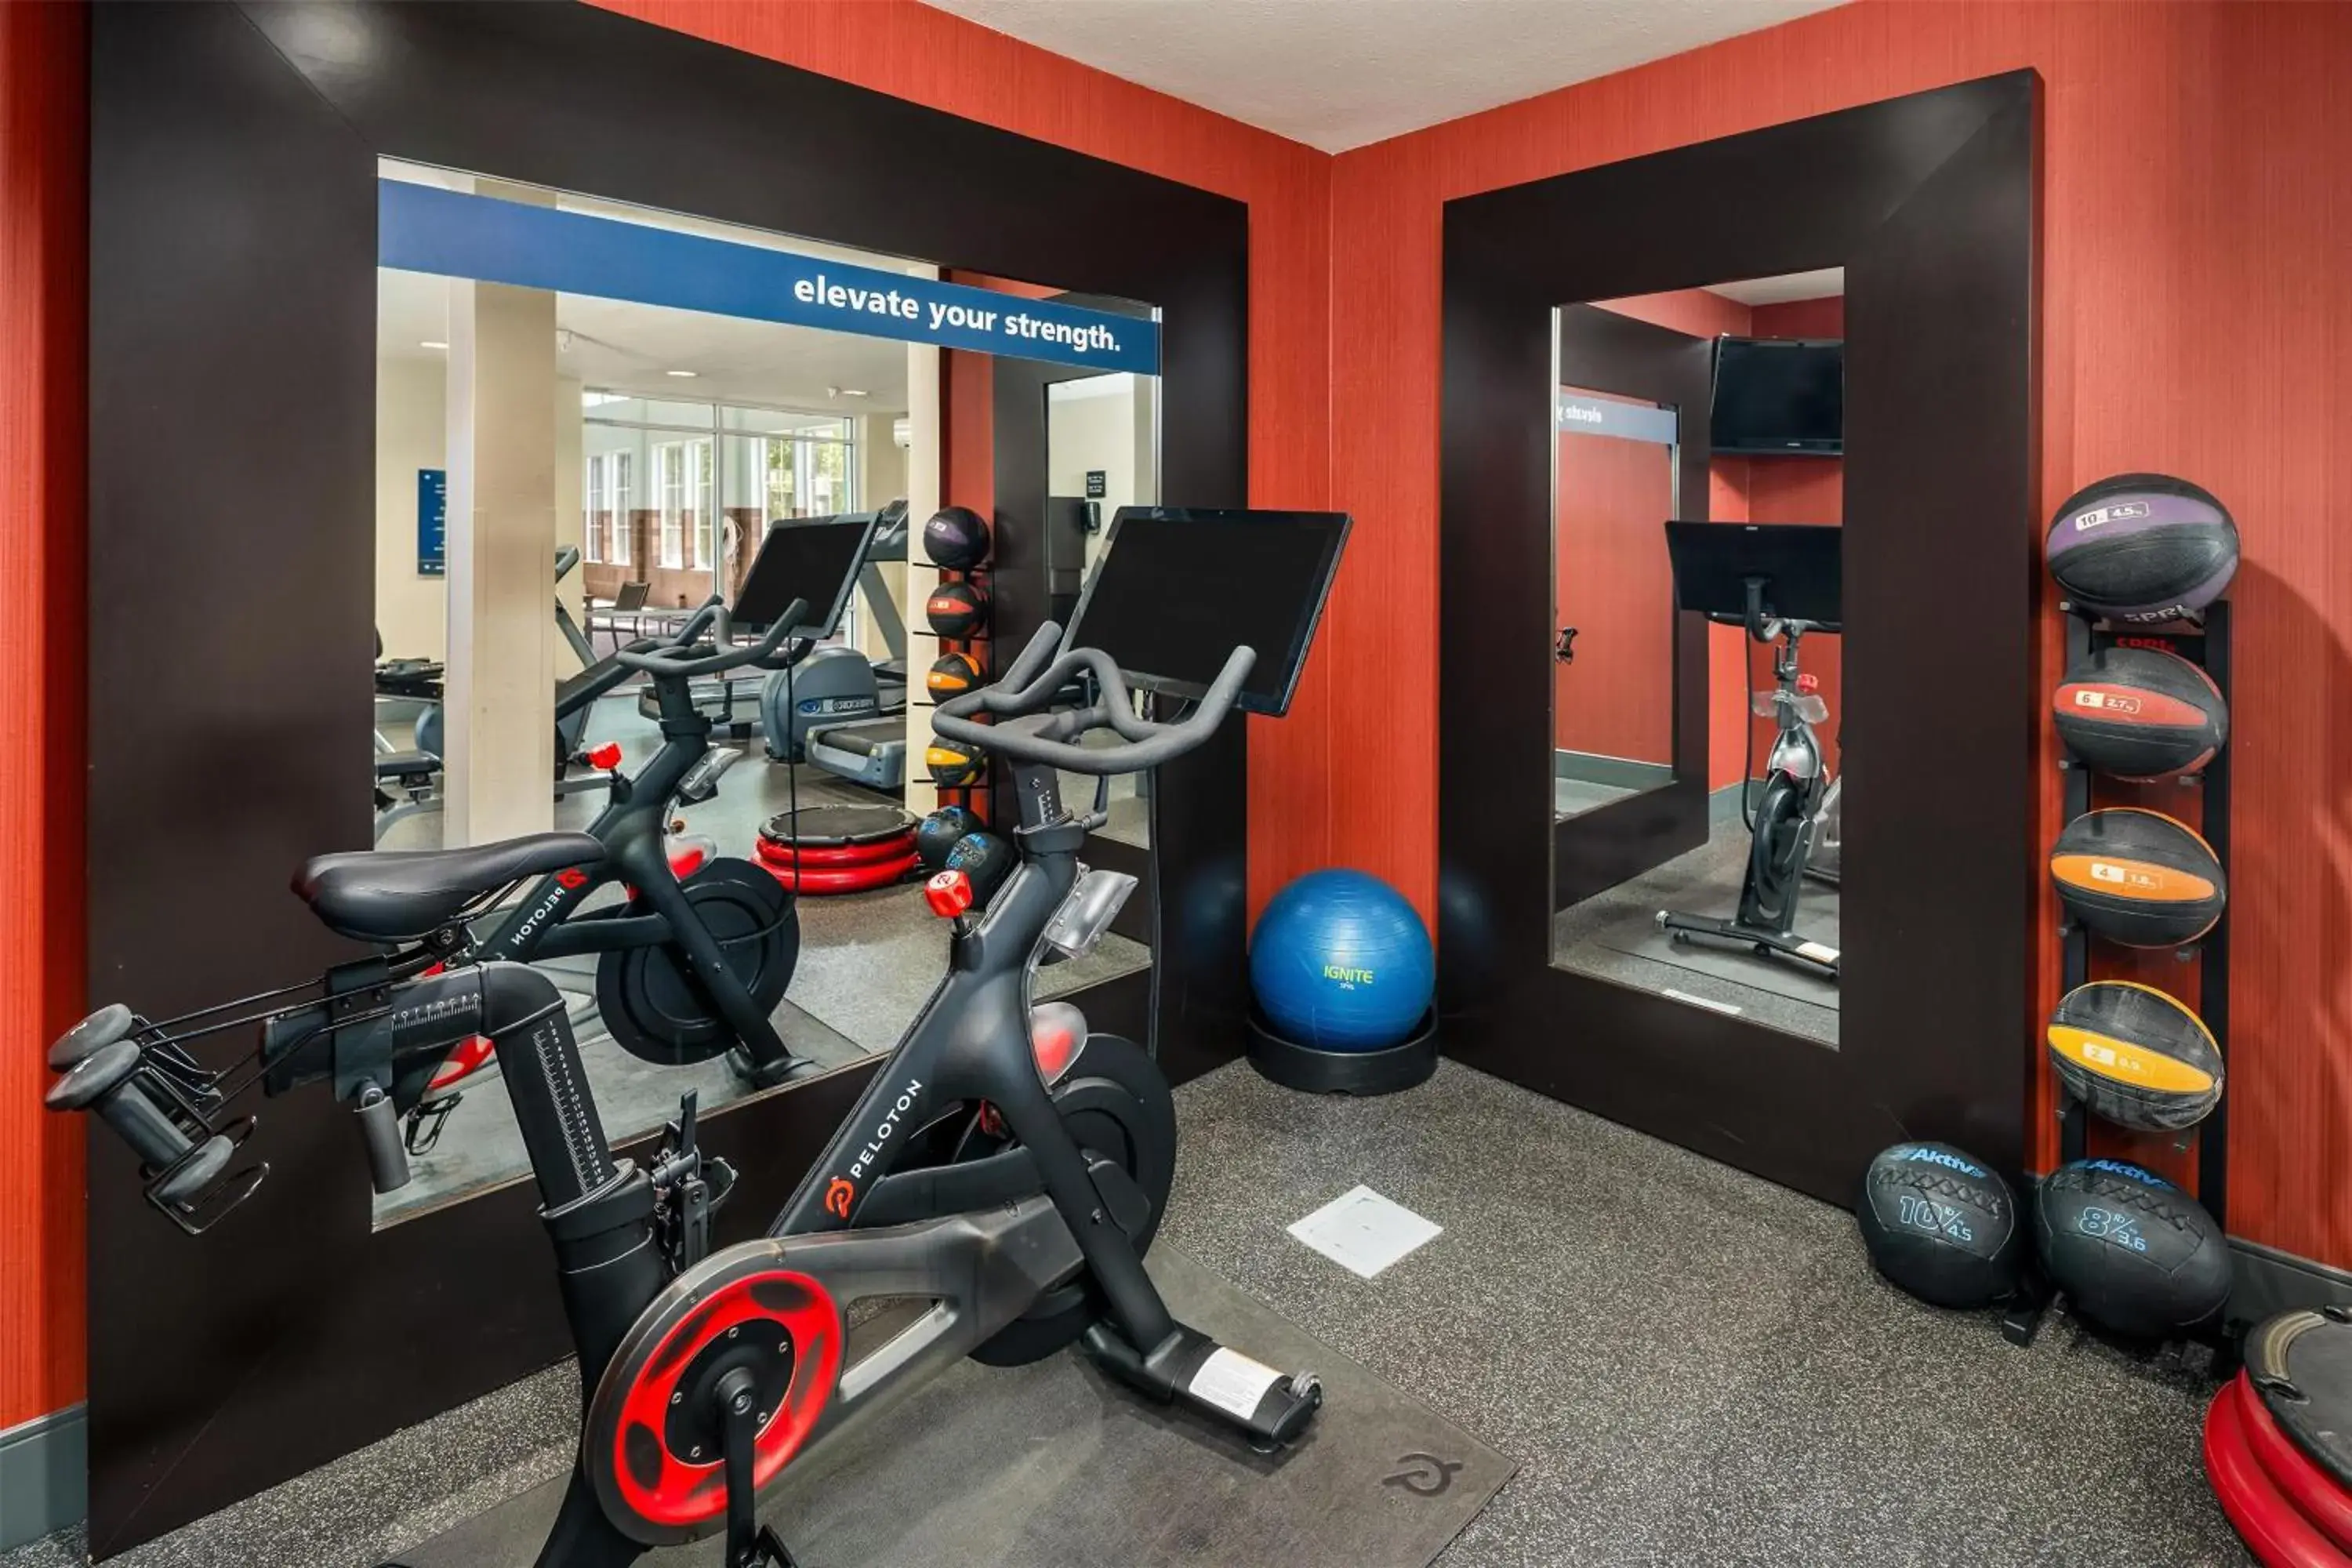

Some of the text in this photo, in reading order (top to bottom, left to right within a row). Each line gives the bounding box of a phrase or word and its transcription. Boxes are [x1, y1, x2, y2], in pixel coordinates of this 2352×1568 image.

[794, 274, 1121, 352] elevate your strength.
[2080, 514, 2097, 526] 10
[2082, 694, 2090, 704] 6
[1323, 965, 1374, 984] IGNITE
[849, 1078, 924, 1179] PELOTON
[1900, 1196, 1943, 1230] 10
[2078, 1207, 2111, 1236] 8
[2118, 1230, 2147, 1251] 3.6
